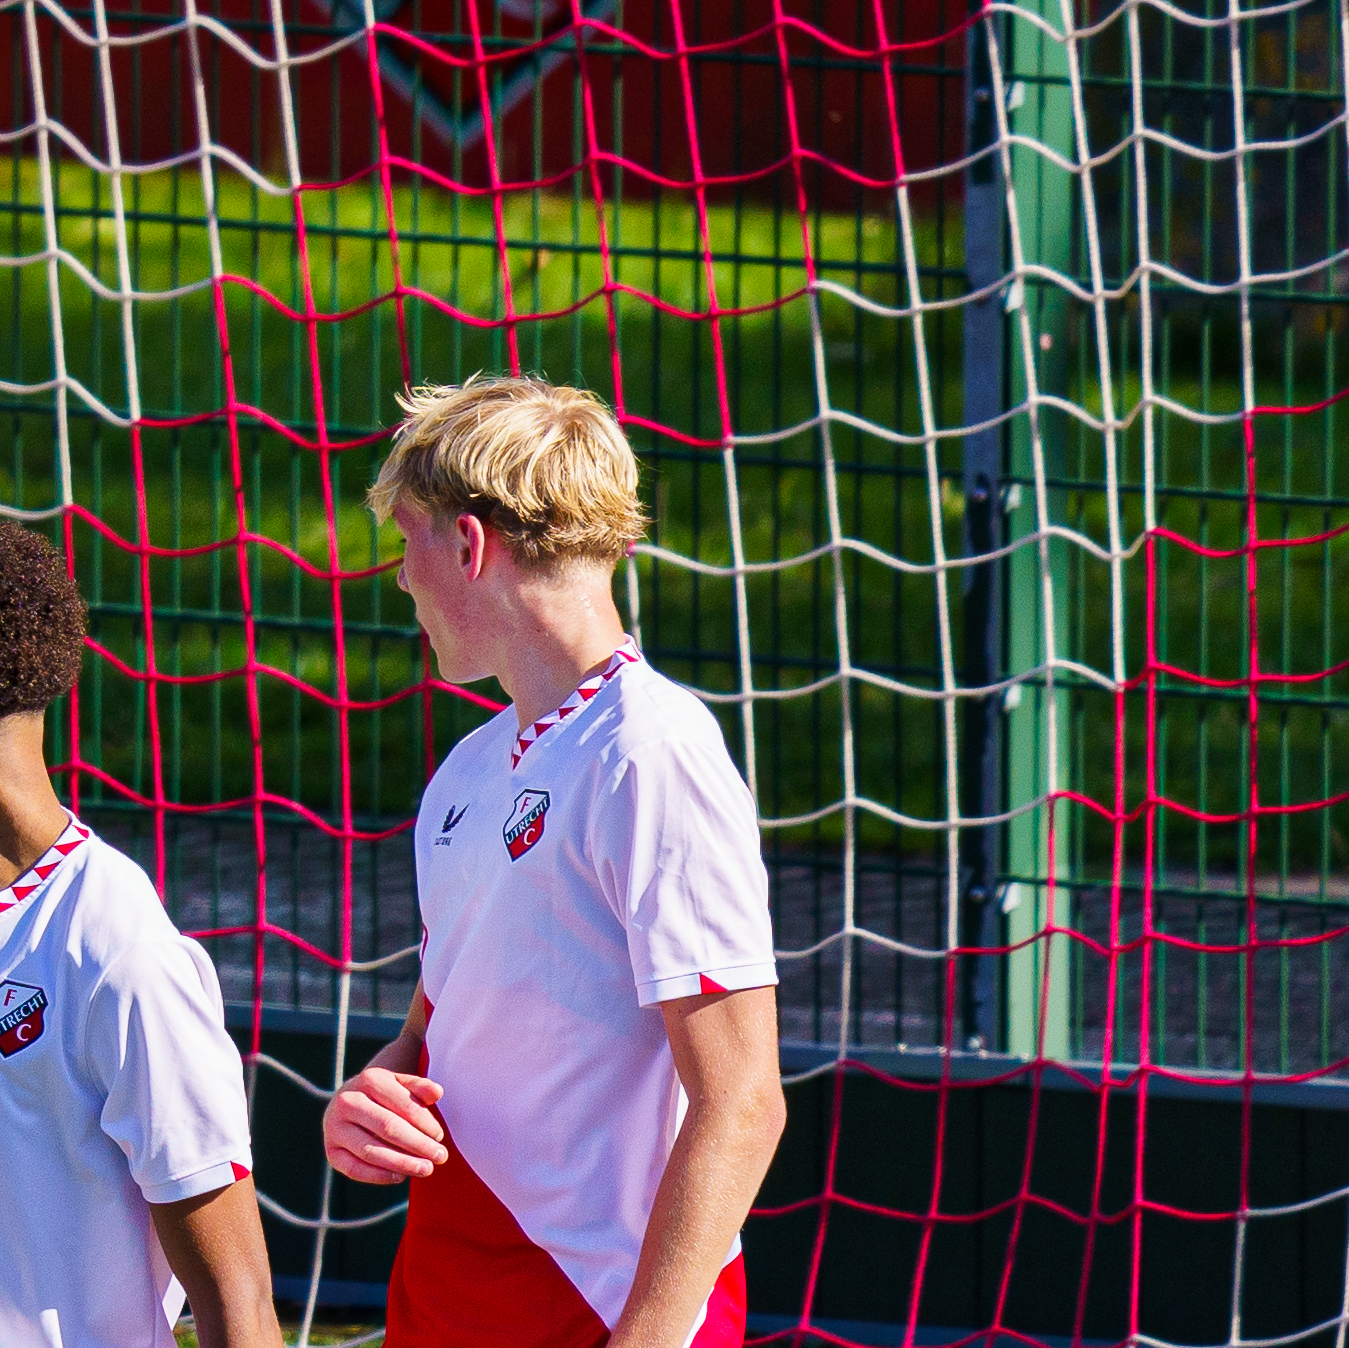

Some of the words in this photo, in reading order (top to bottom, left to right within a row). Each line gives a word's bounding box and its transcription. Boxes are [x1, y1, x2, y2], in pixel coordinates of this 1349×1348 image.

[520, 797, 531, 813] F
[506, 797, 548, 844] UTRECHT
[523, 828, 536, 845] C
[4, 989, 17, 1006] F
[16, 1024, 32, 1041] C
